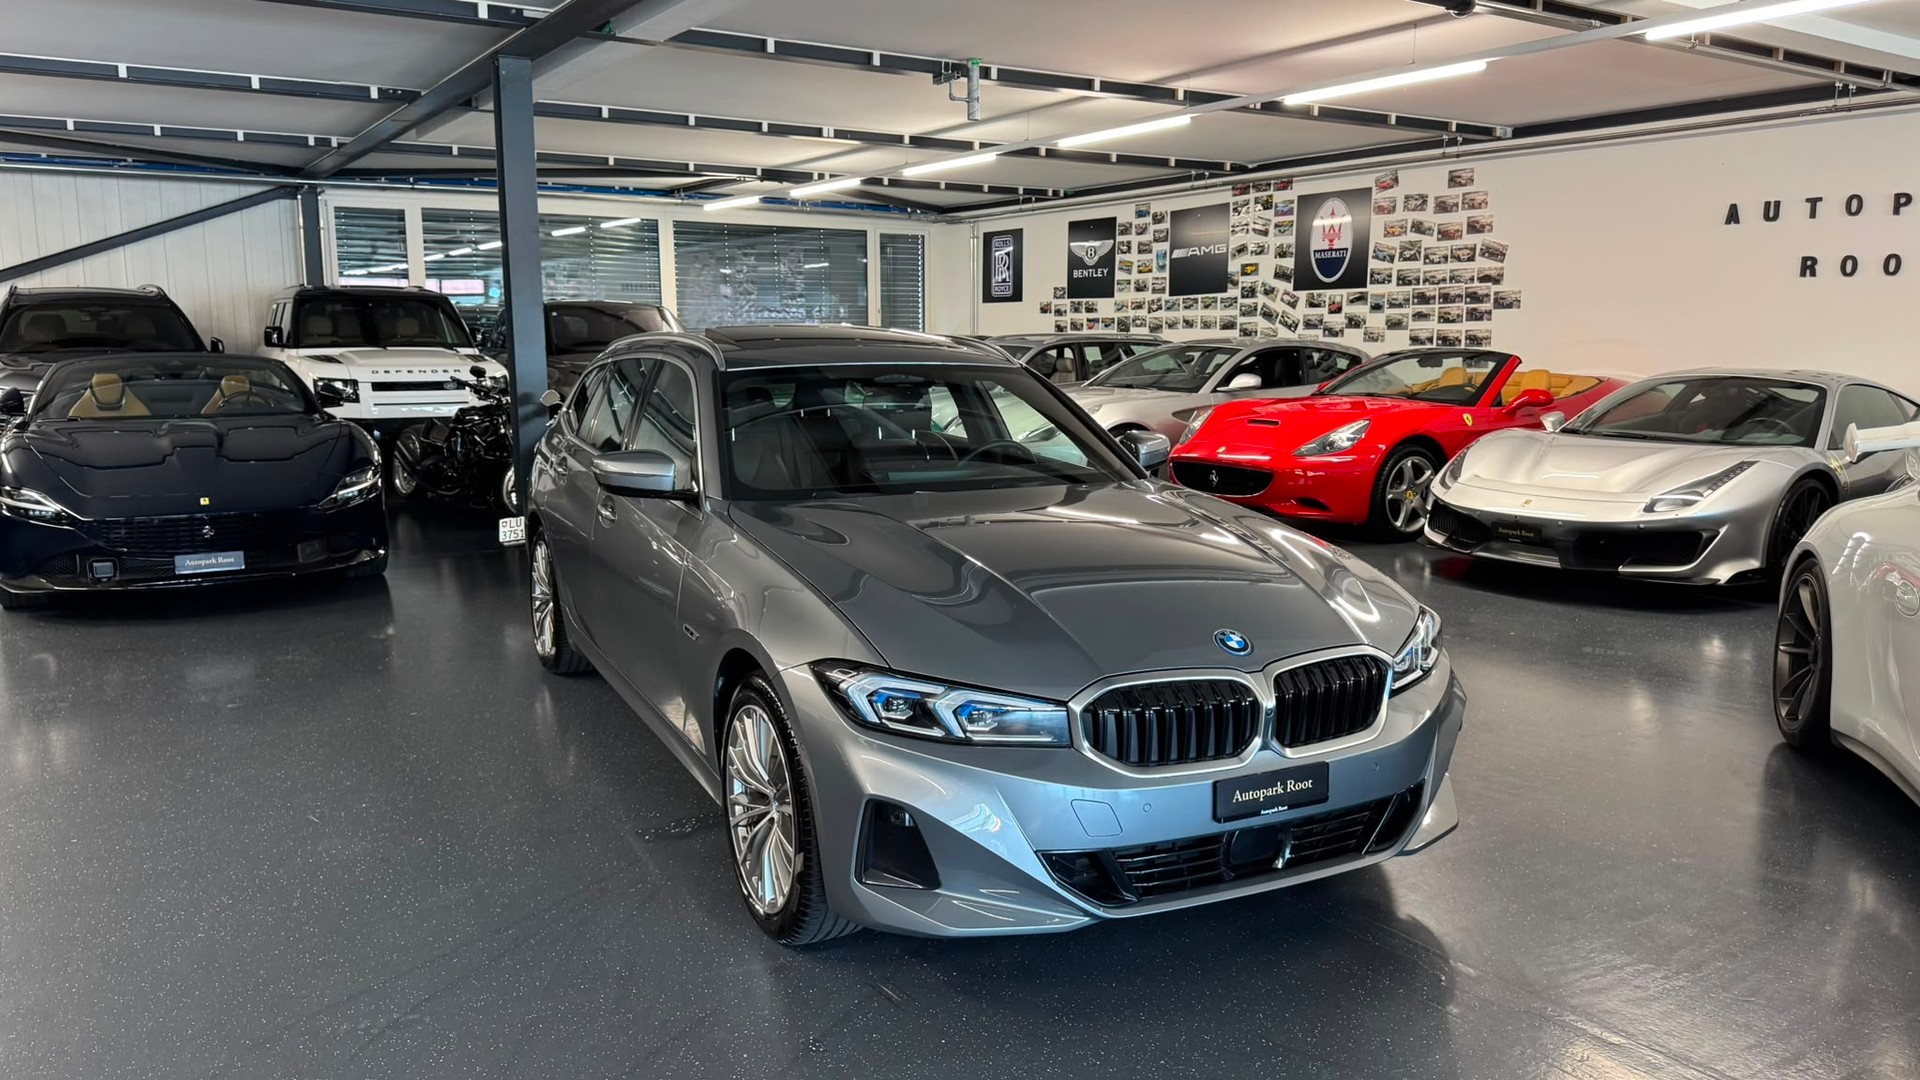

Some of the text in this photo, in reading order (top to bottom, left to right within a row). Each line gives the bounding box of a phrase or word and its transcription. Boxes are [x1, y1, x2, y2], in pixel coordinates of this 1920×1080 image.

[1724, 192, 1913, 225] AUTOP
[1187, 243, 1227, 257] AMG
[1314, 250, 1347, 259] MASERATI
[1799, 253, 1902, 278] ROO
[1073, 268, 1108, 278] BENTLEY
[509, 518, 522, 528] LU
[502, 529, 524, 541] 3751
[185, 557, 217, 567] Autopark
[1232, 779, 1313, 803] Autopark Root
